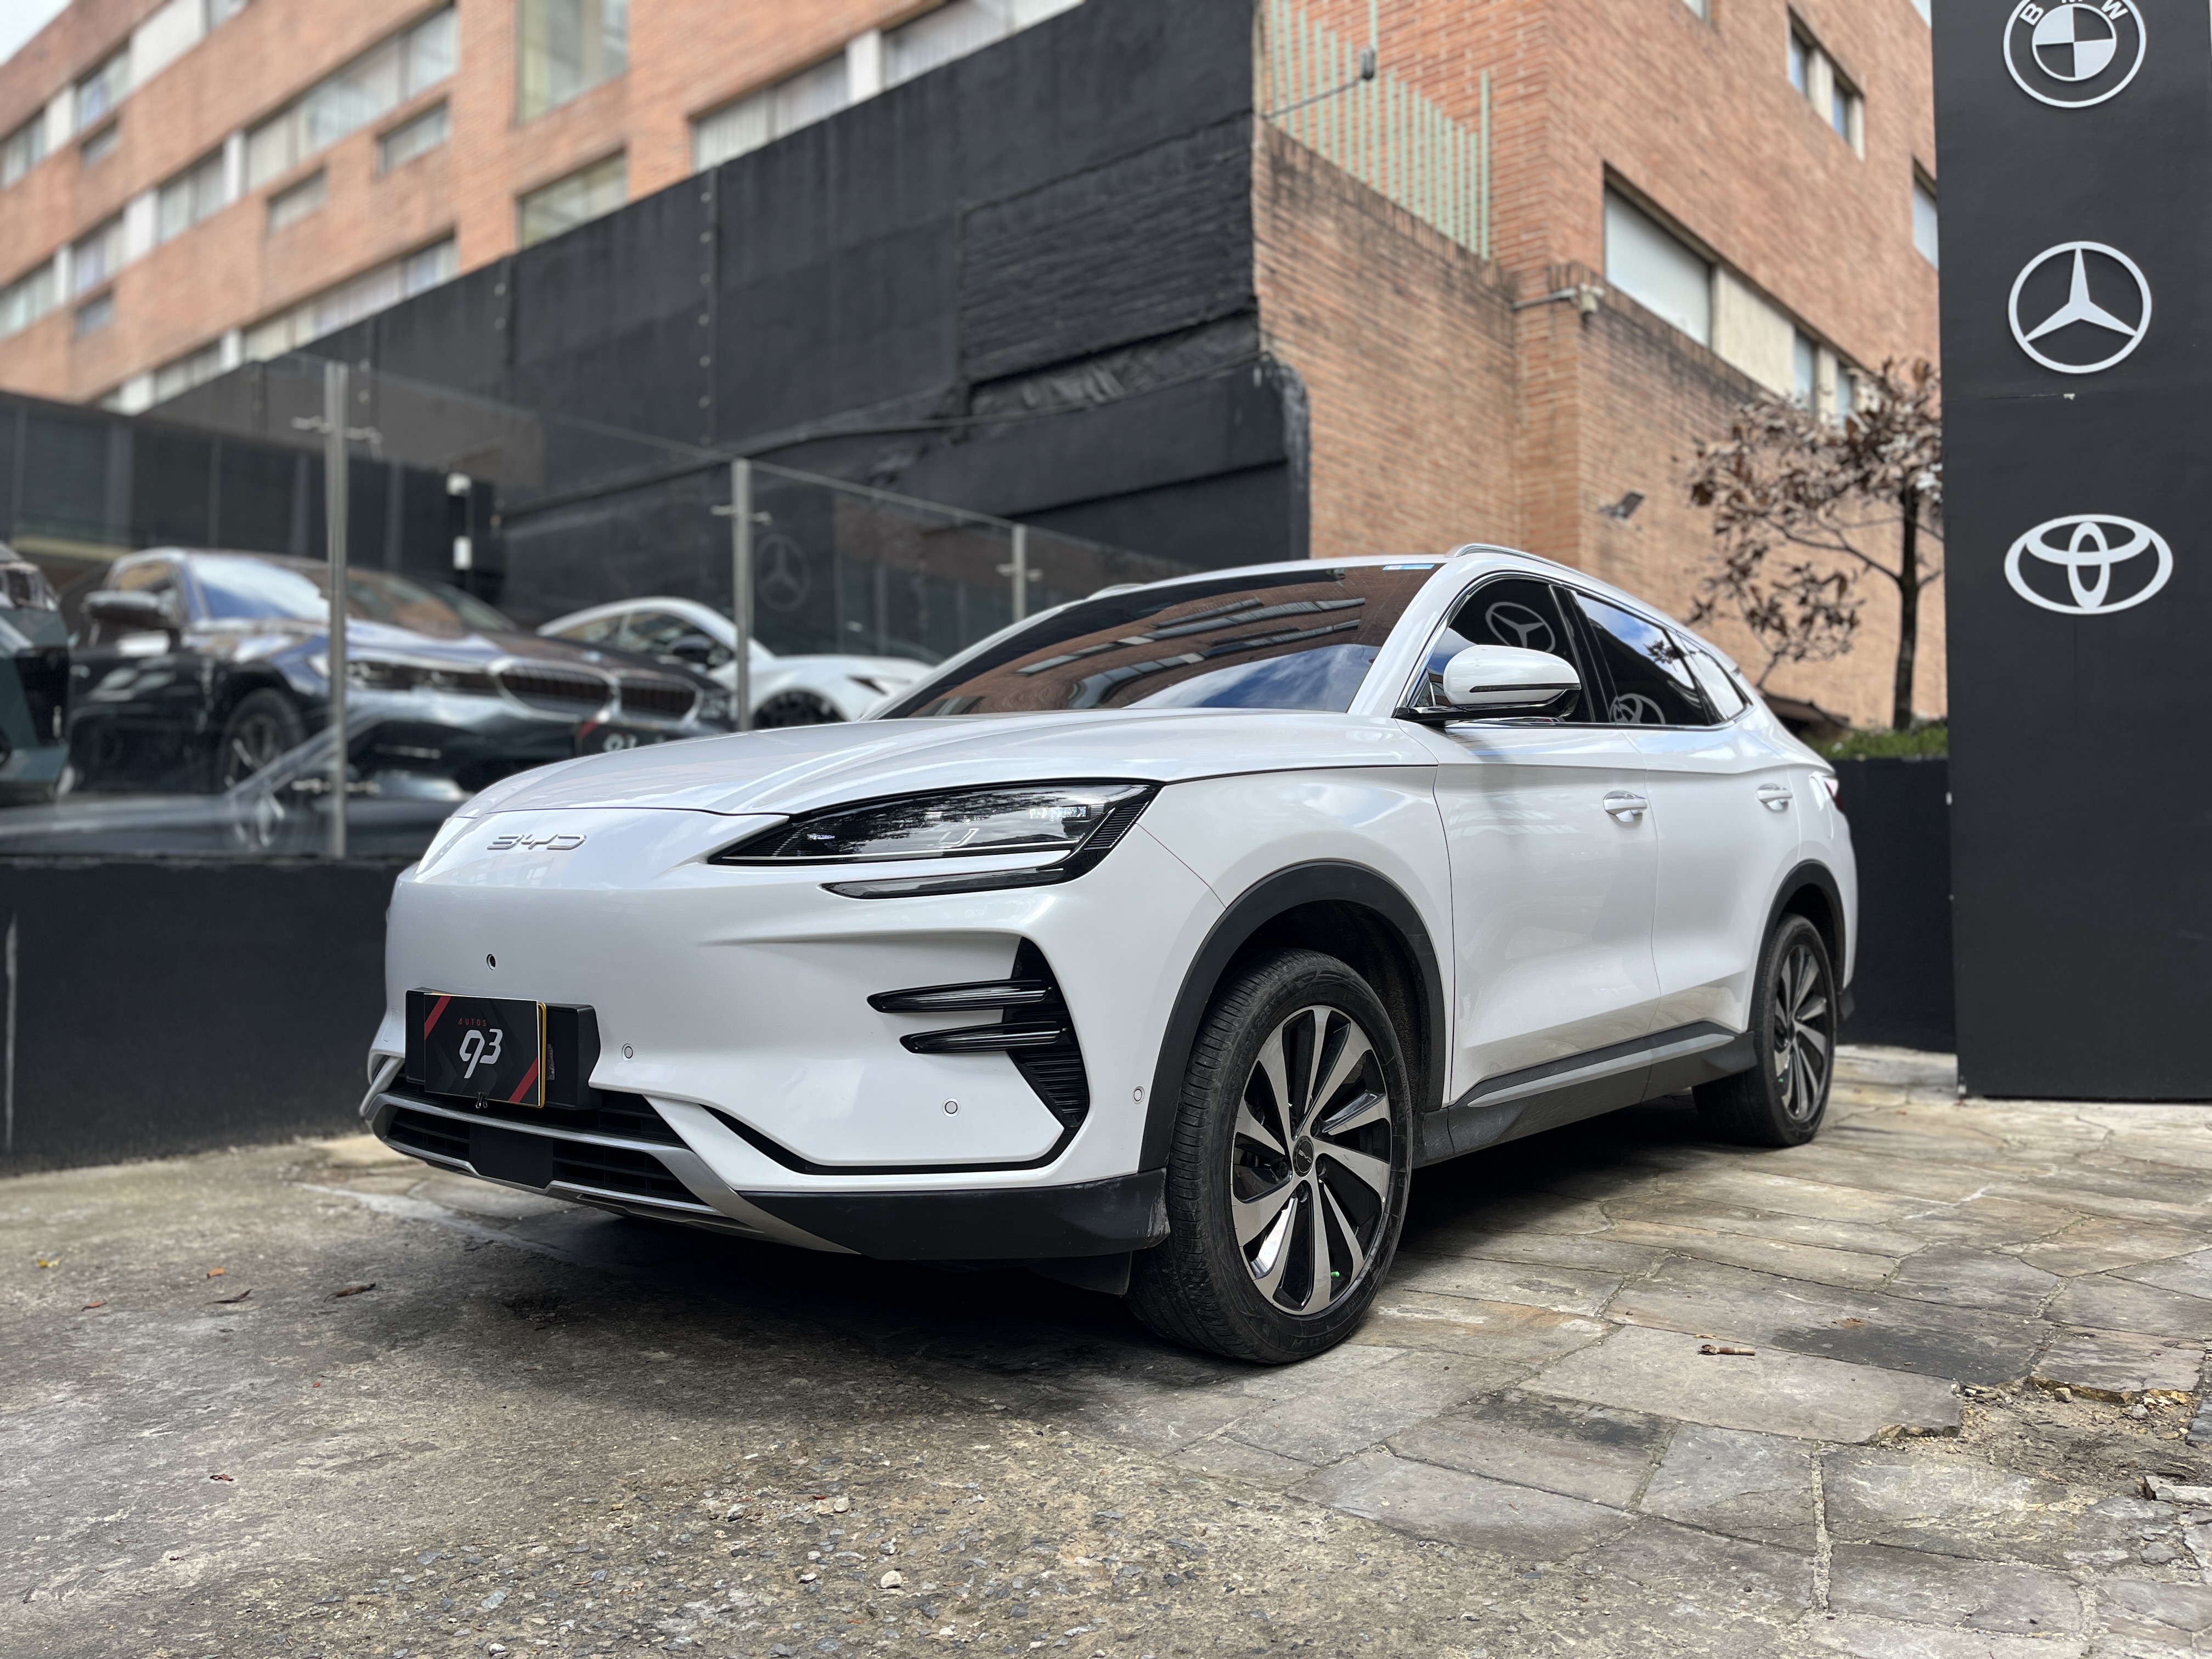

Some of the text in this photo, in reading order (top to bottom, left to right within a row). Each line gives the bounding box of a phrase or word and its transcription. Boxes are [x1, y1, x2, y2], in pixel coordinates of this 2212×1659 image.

[2019, 0, 2128, 26] BW
[487, 834, 586, 850] BYD
[458, 1018, 487, 1026] AUTOS
[459, 1028, 503, 1079] 93
[1298, 1149, 1312, 1163] BYD
